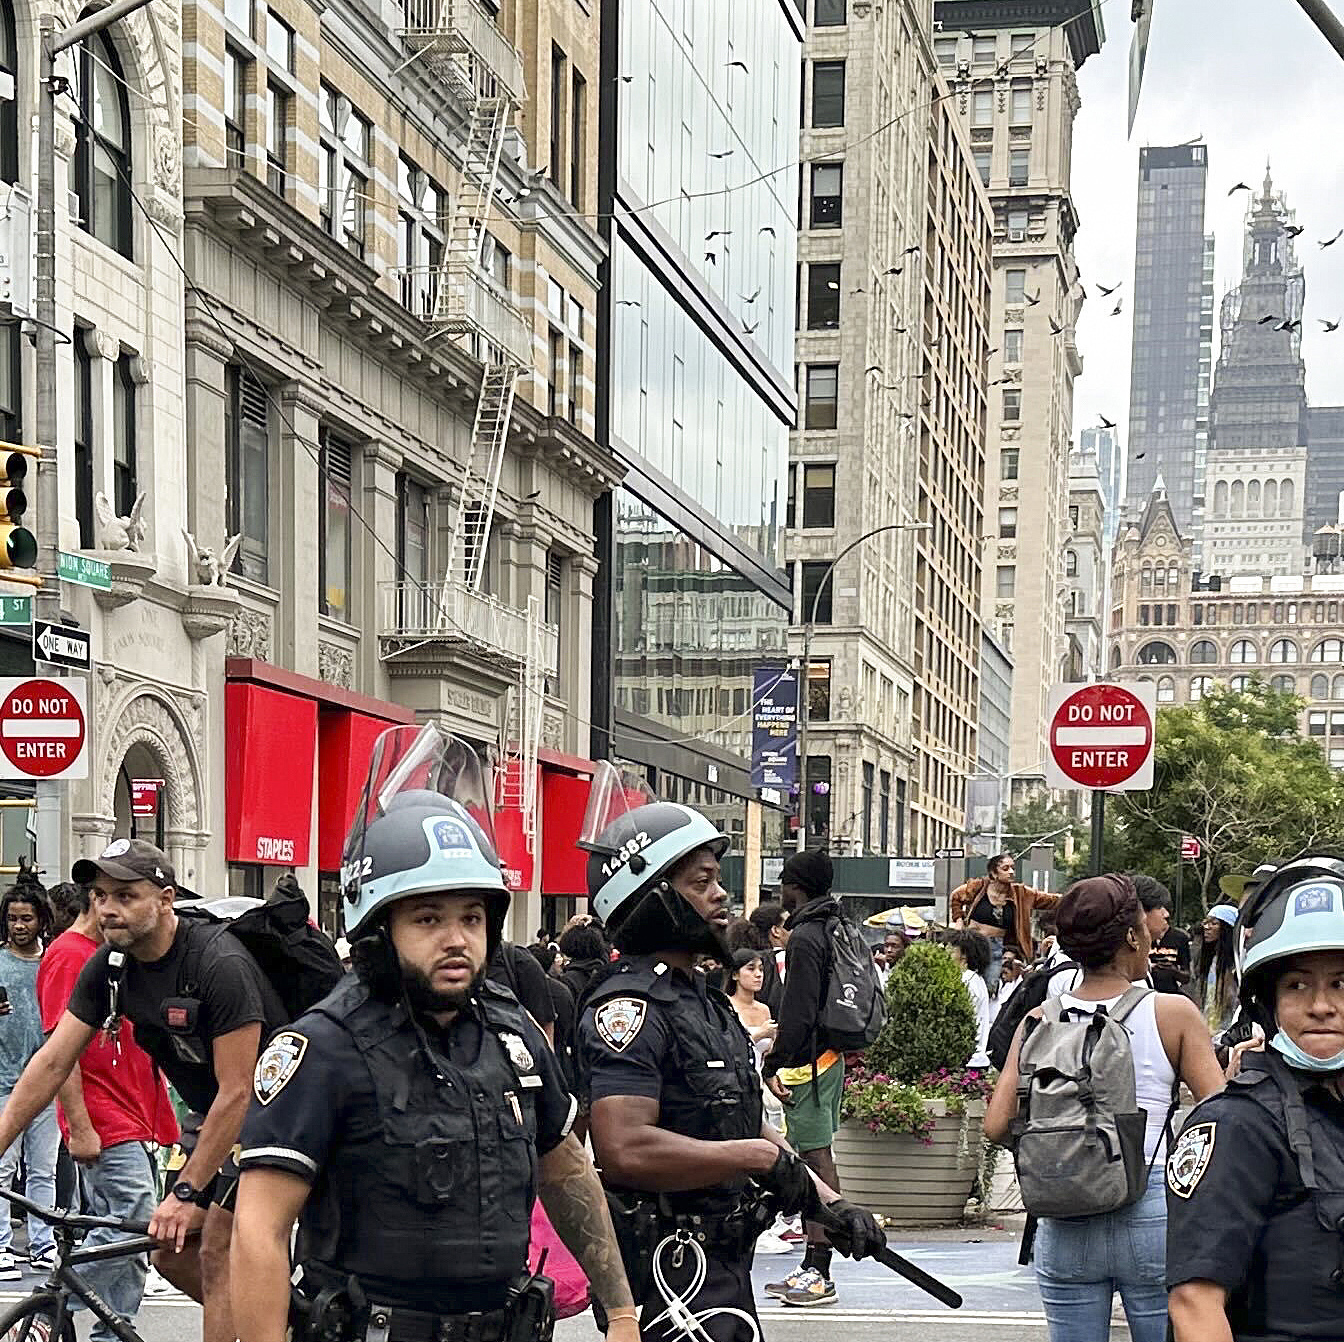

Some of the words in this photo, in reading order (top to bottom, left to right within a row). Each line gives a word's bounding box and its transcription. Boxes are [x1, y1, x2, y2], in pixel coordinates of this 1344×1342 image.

[80, 558, 109, 580] SQUARE
[13, 599, 24, 611] ST
[43, 635, 59, 652] ONE
[67, 640, 83, 657] WAY
[12, 699, 33, 715] DO
[39, 699, 68, 715] NOT
[1068, 705, 1093, 721] DO
[1100, 705, 1135, 721] NOT
[17, 742, 66, 758] ENTER
[1071, 751, 1129, 768] ENTER
[256, 836, 294, 862] STAPLES
